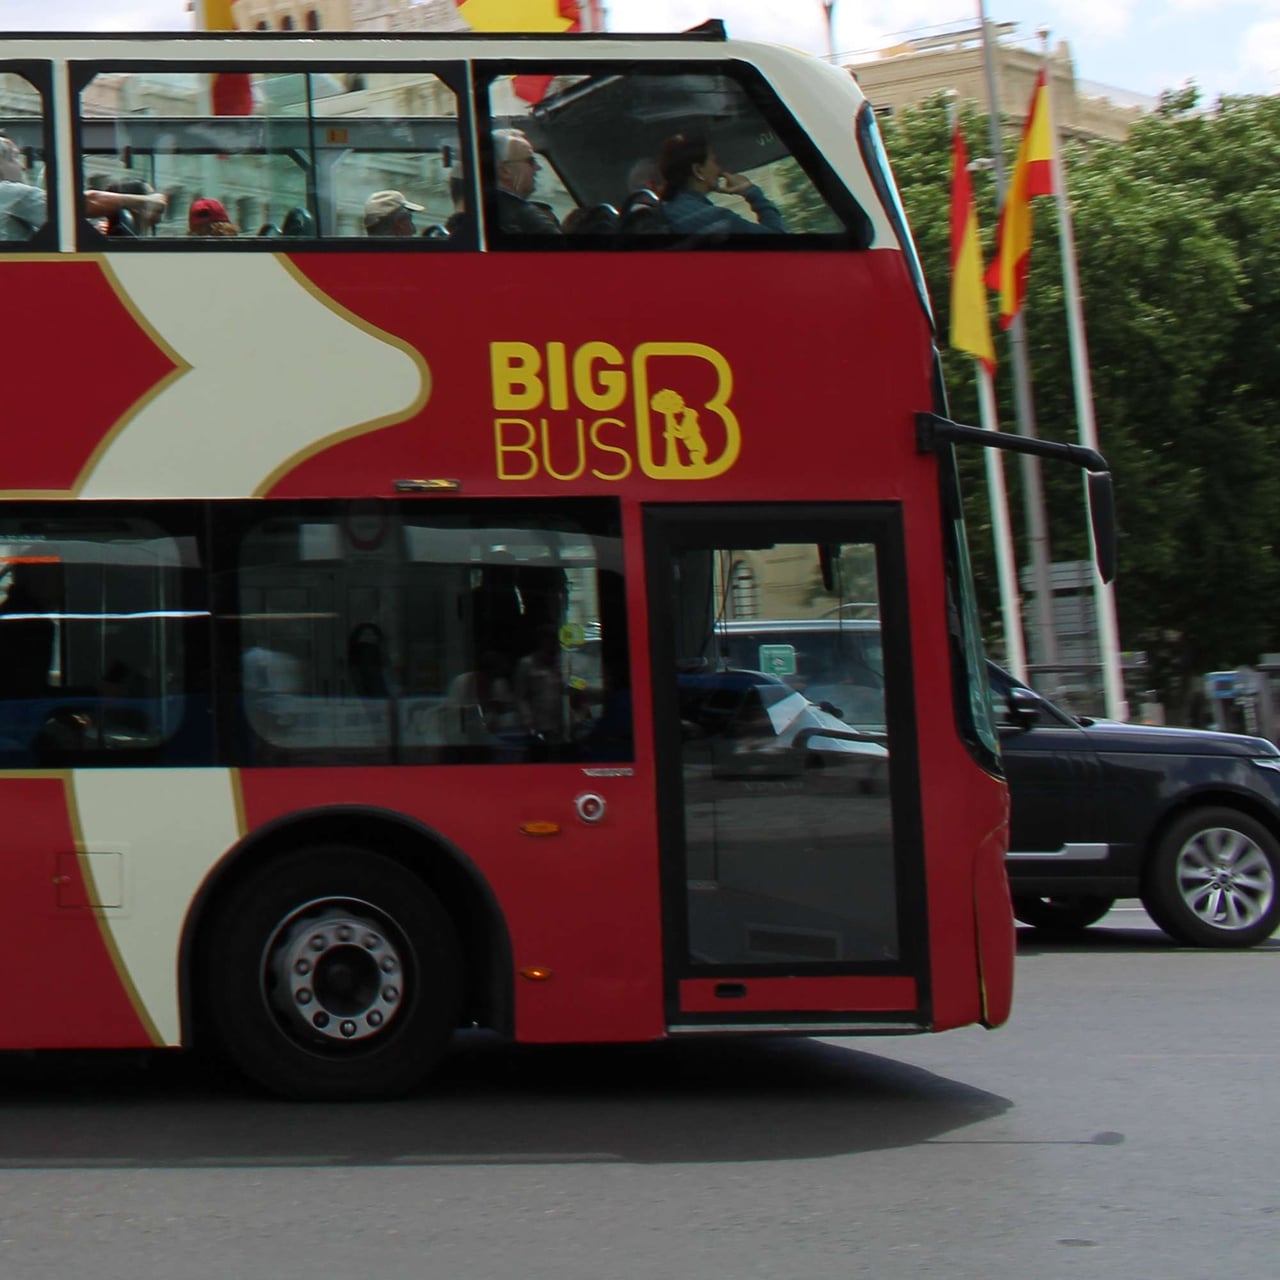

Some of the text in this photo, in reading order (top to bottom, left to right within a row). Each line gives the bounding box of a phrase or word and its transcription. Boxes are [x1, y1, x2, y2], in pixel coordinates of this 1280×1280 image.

[489, 341, 628, 412] BIG
[632, 341, 742, 481] B
[493, 417, 632, 481] BUS
